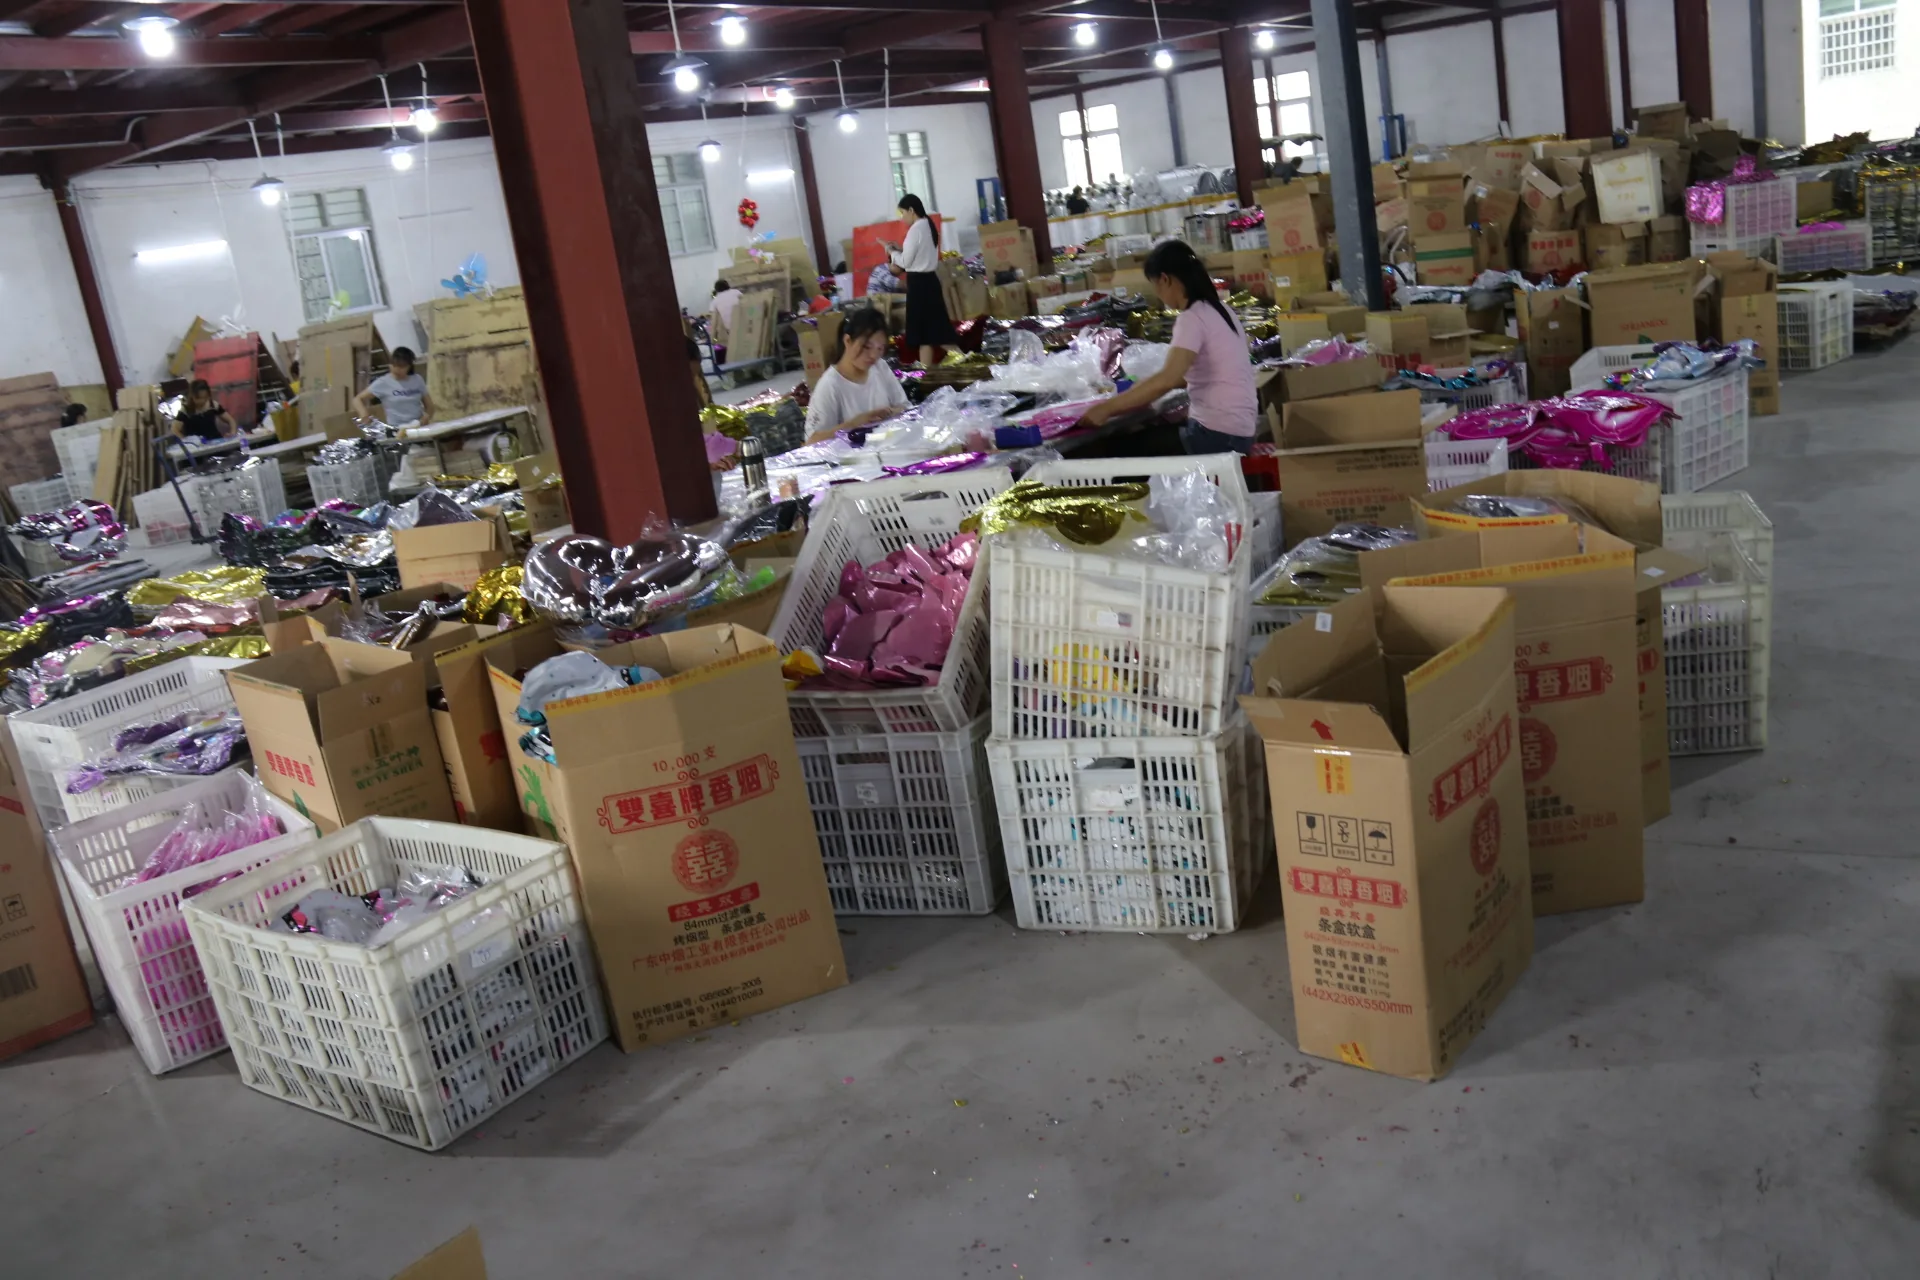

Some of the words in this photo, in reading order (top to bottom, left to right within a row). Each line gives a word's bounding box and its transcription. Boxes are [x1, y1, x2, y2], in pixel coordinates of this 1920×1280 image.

[652, 752, 700, 773] 10,000
[615, 763, 763, 827] 雙喜牌香烟
